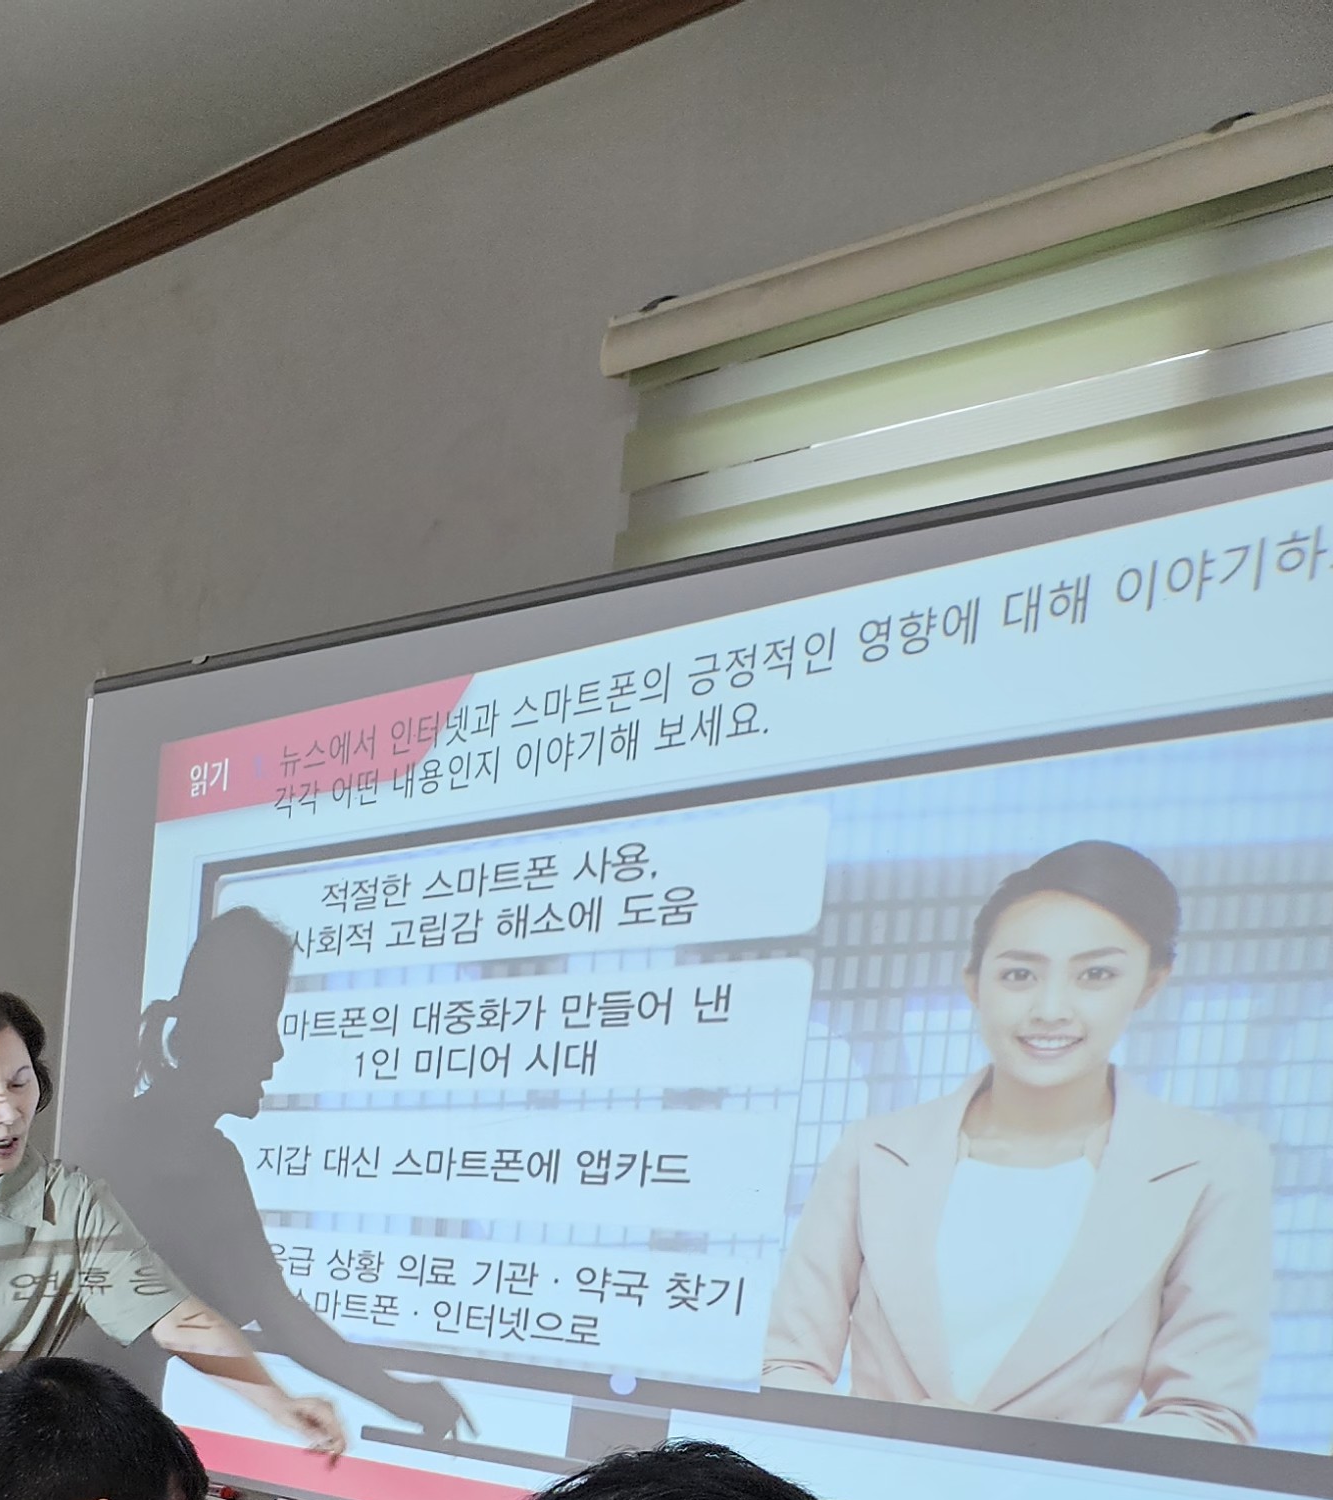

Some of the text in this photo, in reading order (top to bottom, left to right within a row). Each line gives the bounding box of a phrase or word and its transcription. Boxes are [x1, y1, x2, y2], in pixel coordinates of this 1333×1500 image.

[279, 524, 1333, 779] 뉴스에서 인터넷과 스마트폰의 긍정적인 영향에 대해 이야기하
[190, 757, 230, 798] 읽기
[273, 701, 770, 820] 각각 어떤 내용인지 이야기해 보세요.
[320, 841, 659, 915] 적절한 스마트폰 사용,
[293, 885, 699, 960] 사회적 고립감 해소에 도움
[283, 983, 733, 1042] 마트폰의 대중화가 만들어 낸
[354, 1040, 599, 1082] 1인 미디어 시대
[256, 1144, 691, 1189] 지갑 대신 스마트폰에 앱카드
[326, 1247, 385, 1283] 상황
[396, 1252, 457, 1290] 의료
[473, 1259, 539, 1296] 기관
[575, 1266, 651, 1307] 약국
[666, 1271, 746, 1316] 찾기
[433, 1299, 602, 1348] 인터넷으로
